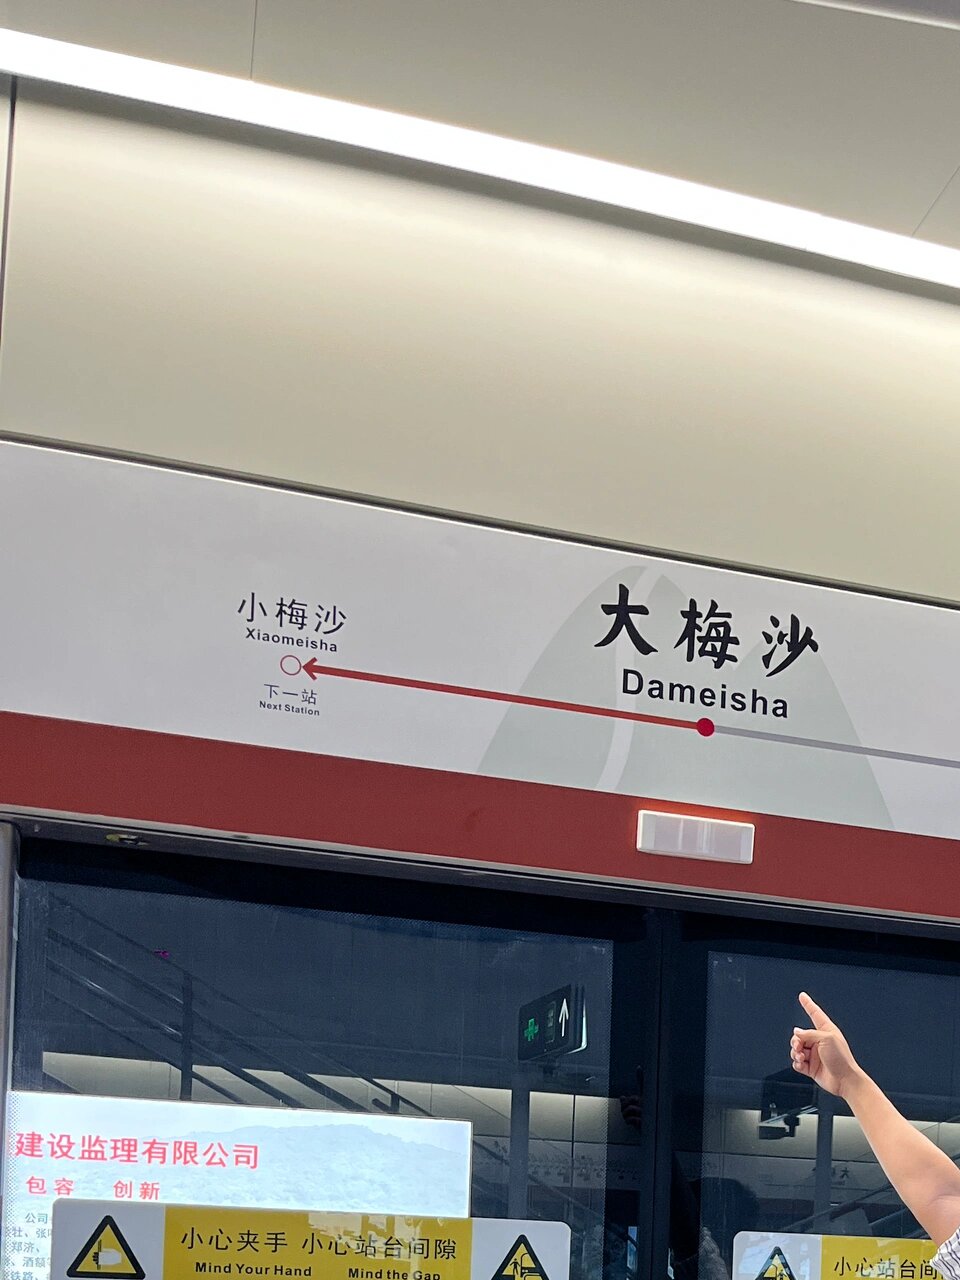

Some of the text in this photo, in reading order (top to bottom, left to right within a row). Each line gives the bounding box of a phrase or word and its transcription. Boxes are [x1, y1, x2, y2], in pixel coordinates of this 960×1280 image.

[238, 592, 346, 634] 小梅沙
[246, 627, 338, 652] Xiaomeisha
[594, 583, 819, 678] 大梅沙
[264, 684, 317, 705] 下一站
[622, 669, 790, 719] Dameisha
[260, 700, 320, 716] Next Station
[16, 1131, 260, 1170] 建设监理有限公司
[26, 1176, 160, 1200] 包容 创新
[25, 1212, 48, 1224] 公司
[181, 1226, 457, 1260] 小心夹手 小心站台间隙
[195, 1261, 232, 1274] Mind
[236, 1263, 270, 1276] Your
[274, 1264, 312, 1278] Hand
[348, 1267, 382, 1280] Mind
[386, 1269, 409, 1280] the
[834, 1256, 943, 1280] 小心站台间
